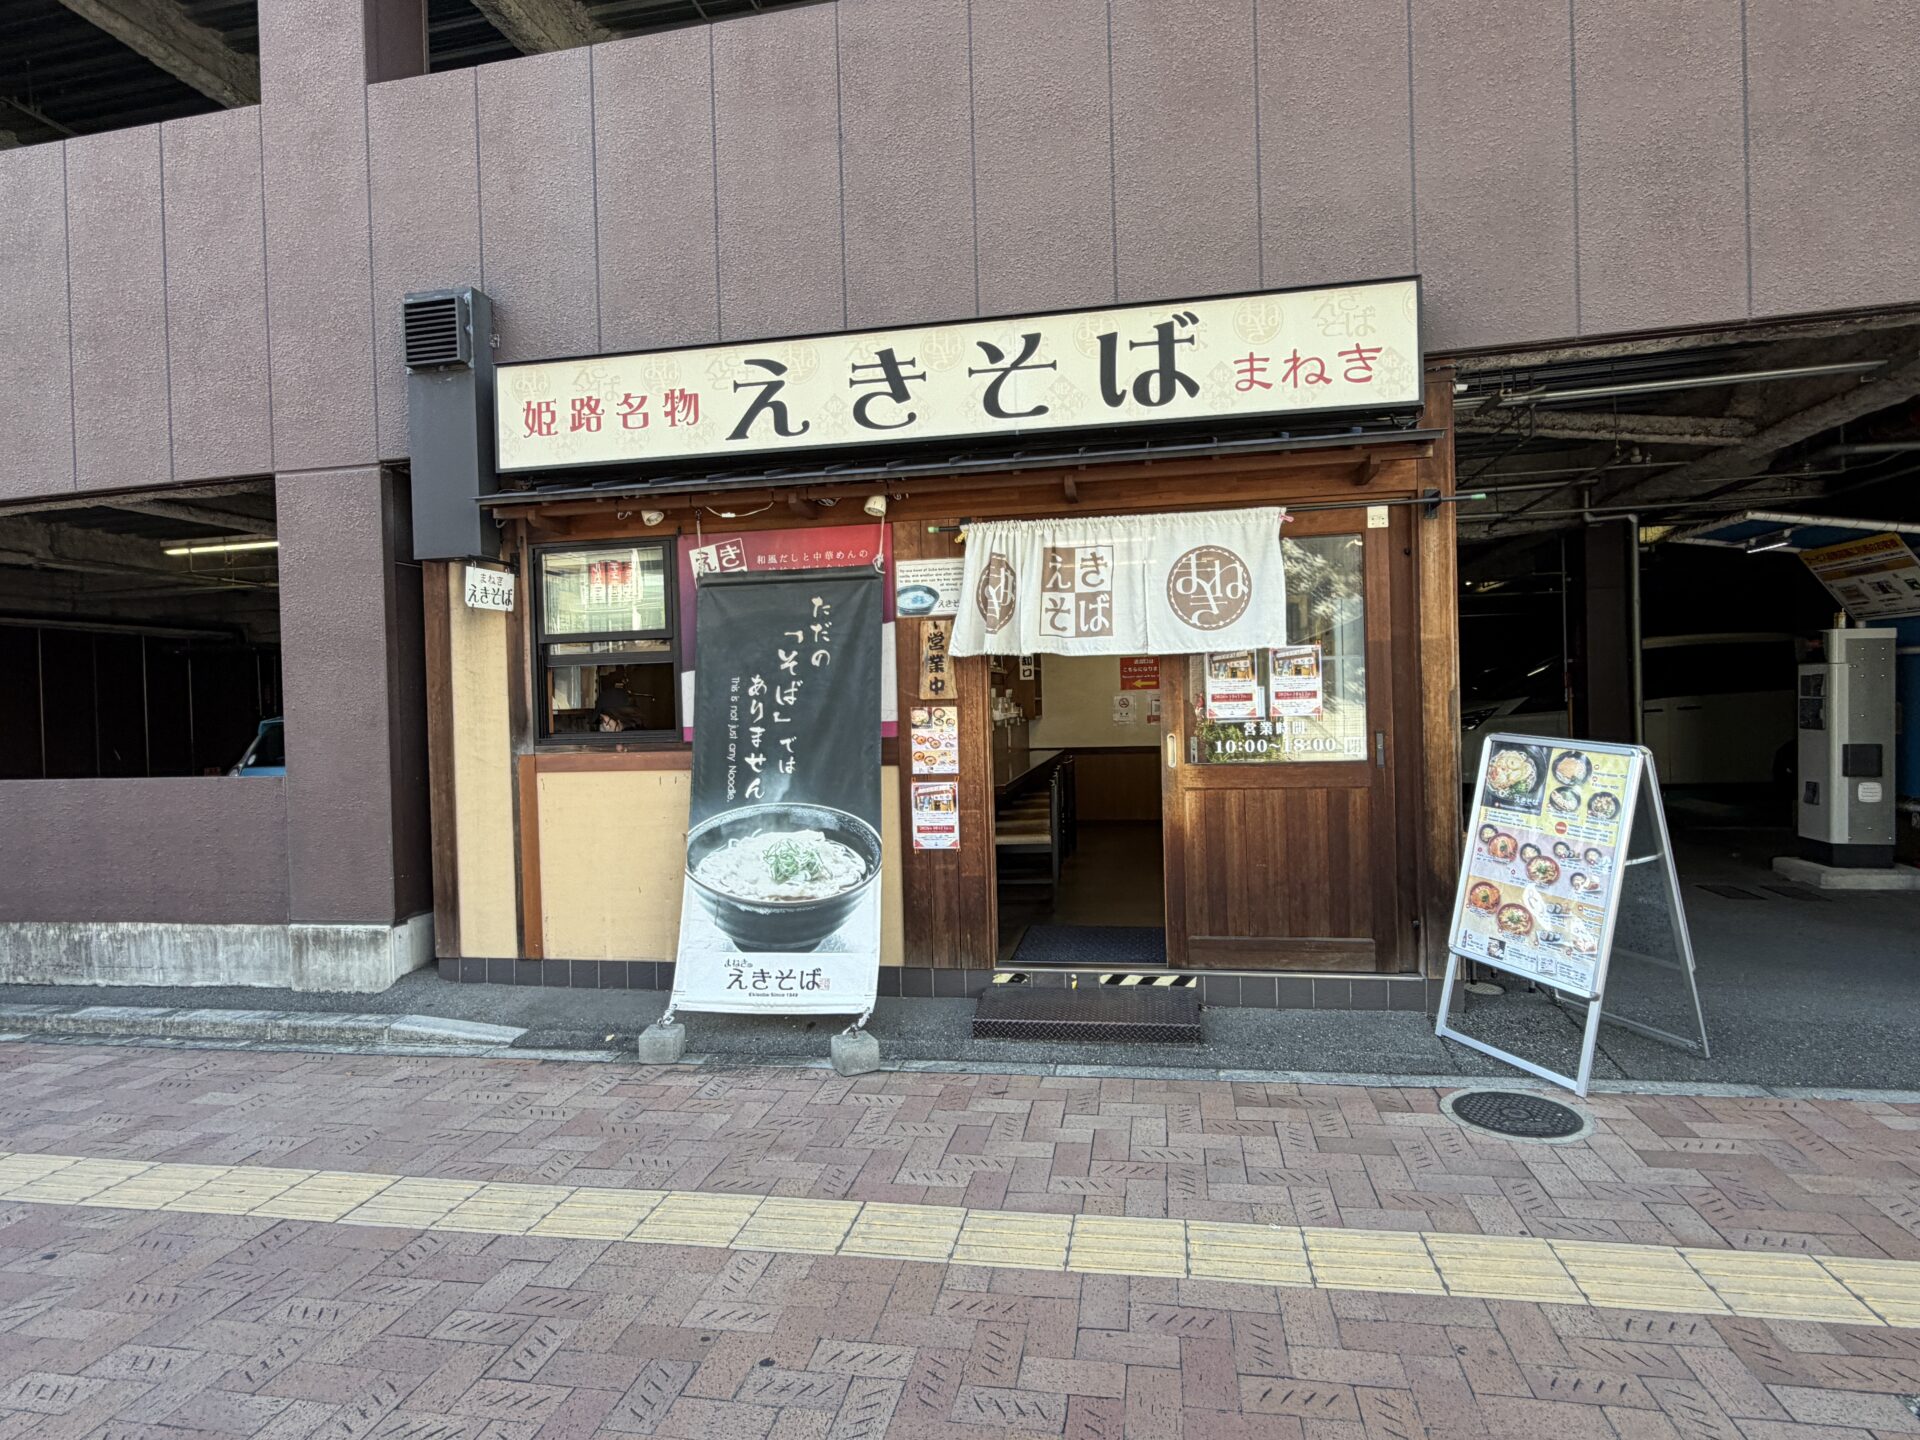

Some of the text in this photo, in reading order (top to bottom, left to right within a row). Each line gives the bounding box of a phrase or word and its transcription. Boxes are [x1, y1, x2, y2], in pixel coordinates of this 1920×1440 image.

[523, 388, 699, 438] 姫路名物
[725, 311, 1200, 441] えきそば
[1233, 343, 1383, 391] まねき
[756, 550, 868, 564] 和風だしと中華めんの
[480, 573, 504, 586] まねき
[468, 584, 513, 606] えきそば
[810, 596, 832, 667] ただの
[928, 632, 946, 696] 営業中
[731, 676, 740, 692] This
[730, 705, 740, 721] not
[773, 630, 803, 774] 「そば」では
[727, 724, 740, 740] just
[744, 674, 767, 799] ありません
[1243, 721, 1307, 736] 営業時間
[726, 743, 737, 762] any
[726, 765, 737, 803] Noodle.
[726, 968, 822, 991] えきそば
